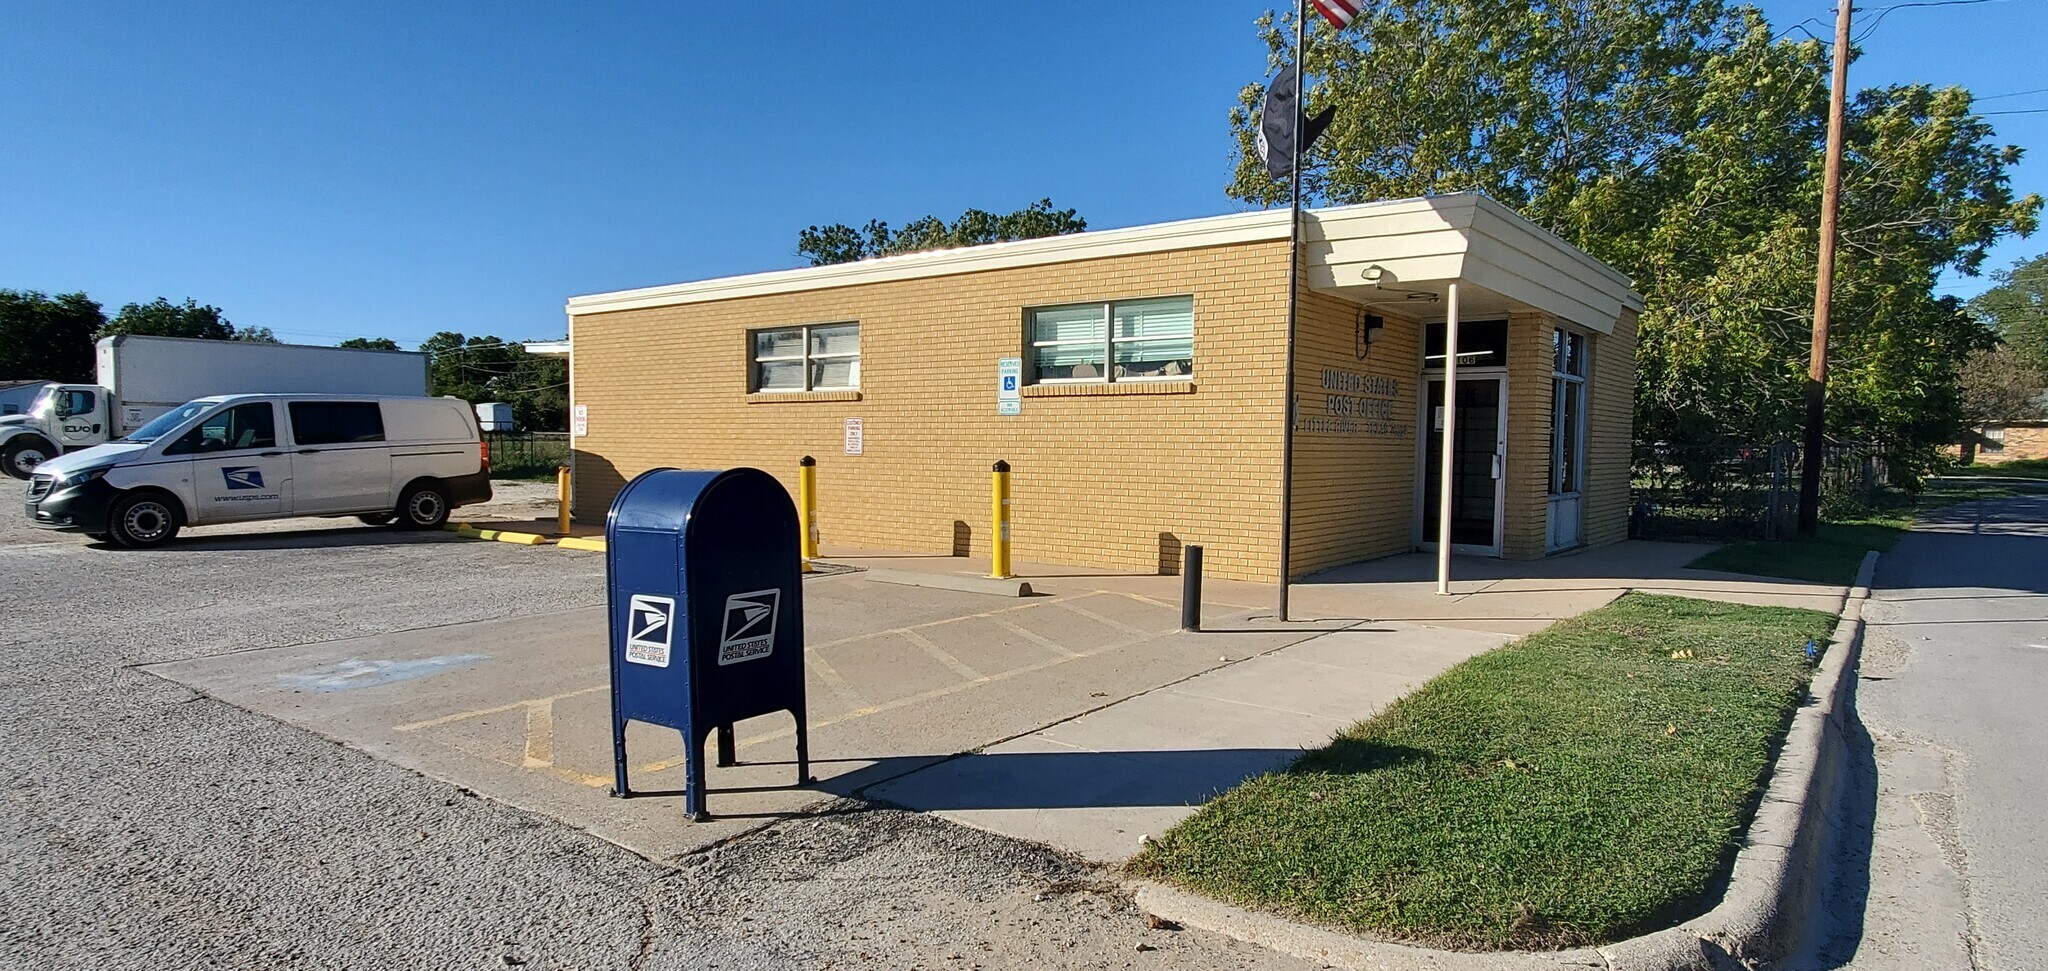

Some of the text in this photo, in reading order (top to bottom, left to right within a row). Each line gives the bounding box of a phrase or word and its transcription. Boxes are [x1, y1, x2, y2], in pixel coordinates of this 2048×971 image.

[1322, 368, 1398, 397] UNITED STATES
[1327, 394, 1395, 420] POST OFFICE
[1304, 418, 1335, 433] LITTLE
[1336, 420, 1359, 434] RIVER
[630, 644, 648, 652] UNITED
[723, 639, 768, 652] UNITED STATES
[629, 652, 666, 663] POSTAL SERVICE
[722, 647, 770, 661] POSTAL SERVICE
